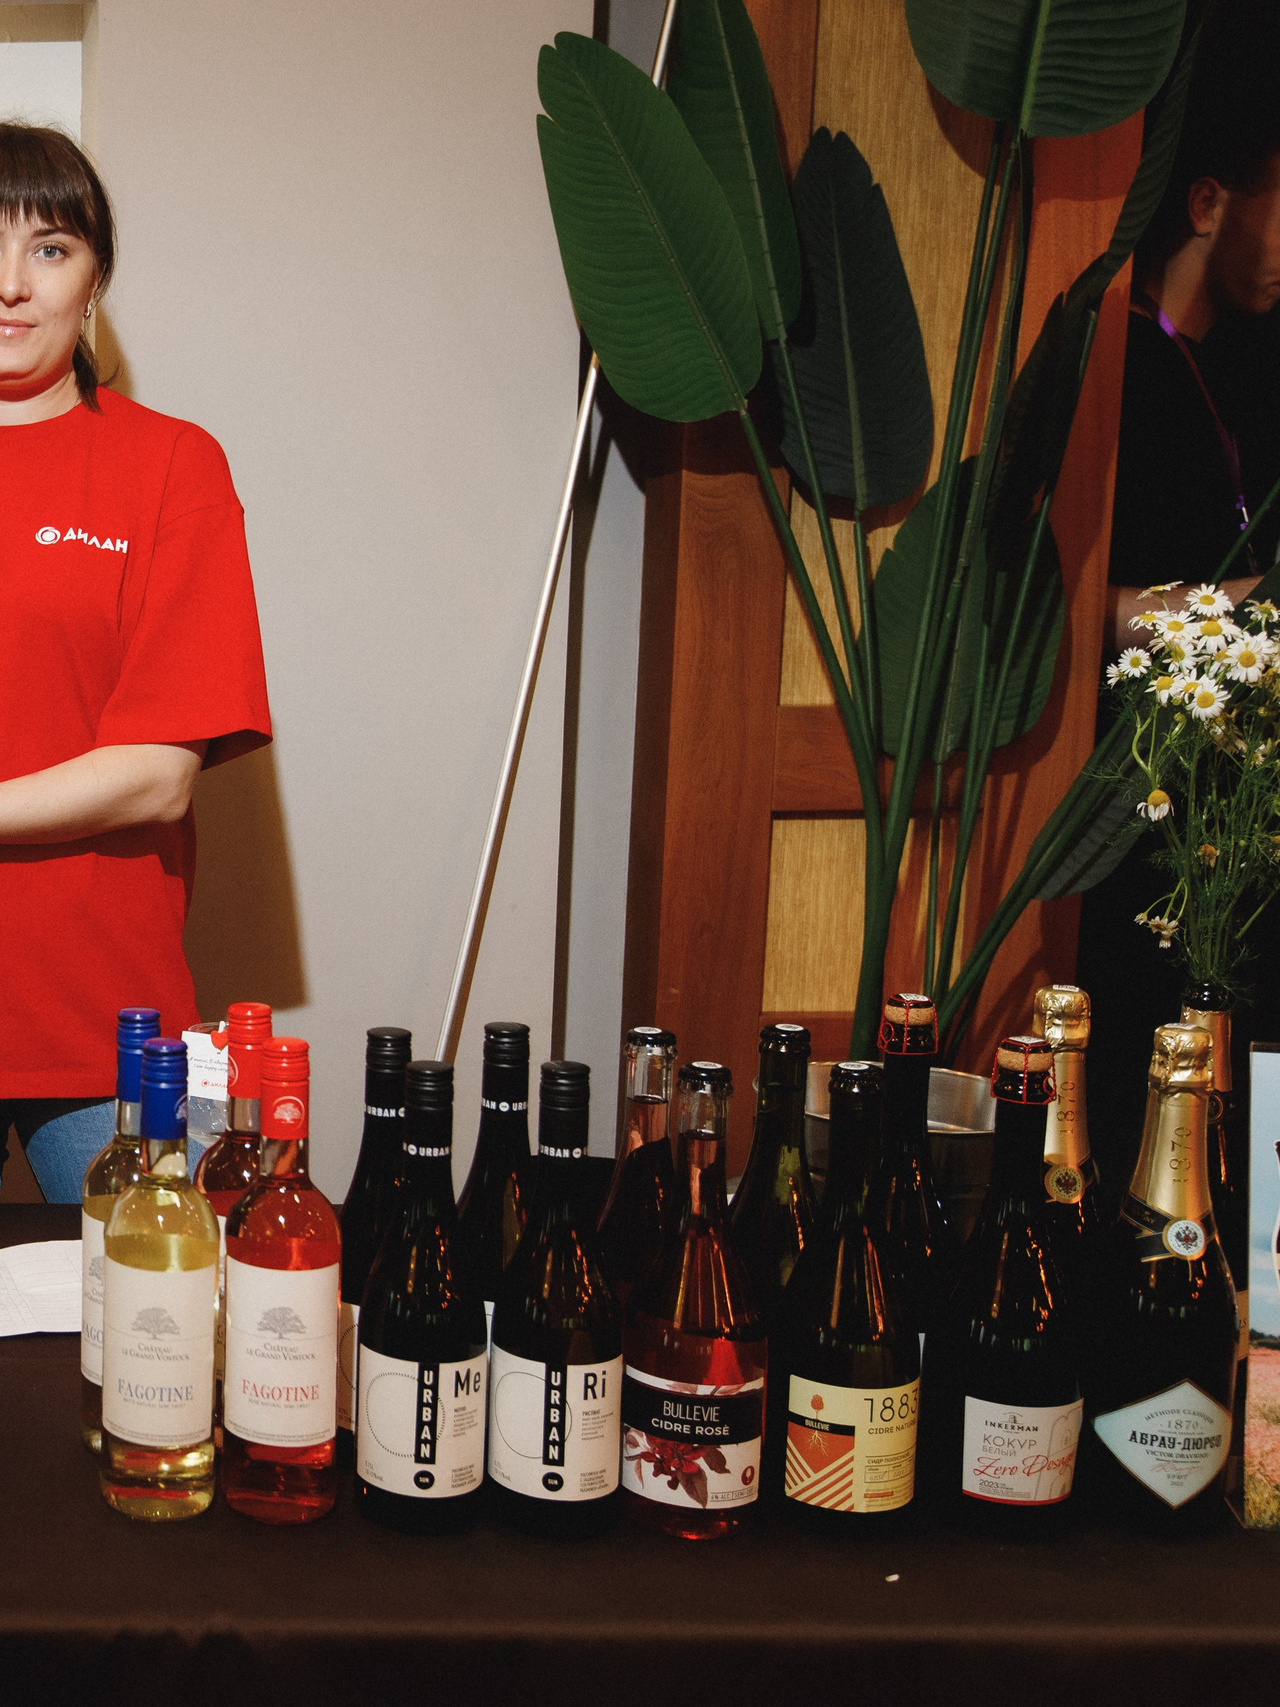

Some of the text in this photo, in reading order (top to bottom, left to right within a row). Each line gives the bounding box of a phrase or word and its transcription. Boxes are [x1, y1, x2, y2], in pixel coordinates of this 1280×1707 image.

[62, 527, 129, 554] ДИЛАН
[210, 1081, 228, 1089] ДИЛА
[366, 1105, 396, 1118] URBAN
[482, 1098, 527, 1111] BAN URB
[1056, 1081, 1076, 1135] 1870
[540, 1144, 570, 1158] URBAN
[1169, 1126, 1192, 1183] 1870
[254, 1348, 281, 1360] GRAND
[117, 1378, 193, 1402] FAGOTINE
[242, 1378, 320, 1402] FAGOTINE
[454, 1367, 481, 1398] Me
[583, 1370, 606, 1400] Ri
[663, 1400, 720, 1422] BULLEVIE
[863, 1387, 918, 1423] 1883
[420, 1370, 434, 1458] URBAN
[548, 1371, 561, 1460] URBAN
[651, 1418, 691, 1434] CIDRE
[804, 1418, 830, 1432] BULLEVIE
[867, 1426, 894, 1435] CIDRE
[985, 1420, 1039, 1432] INKERMAN
[1167, 1420, 1199, 1430] 1870
[982, 1433, 1037, 1449] КОКУР
[1128, 1429, 1222, 1451] АБРАУ-ДЮРСО
[982, 1445, 1016, 1457] БЕЛЫЙ
[1145, 1449, 1174, 1458] VICTOR
[973, 1456, 1019, 1479] Zero
[979, 1479, 999, 1489] 2023
